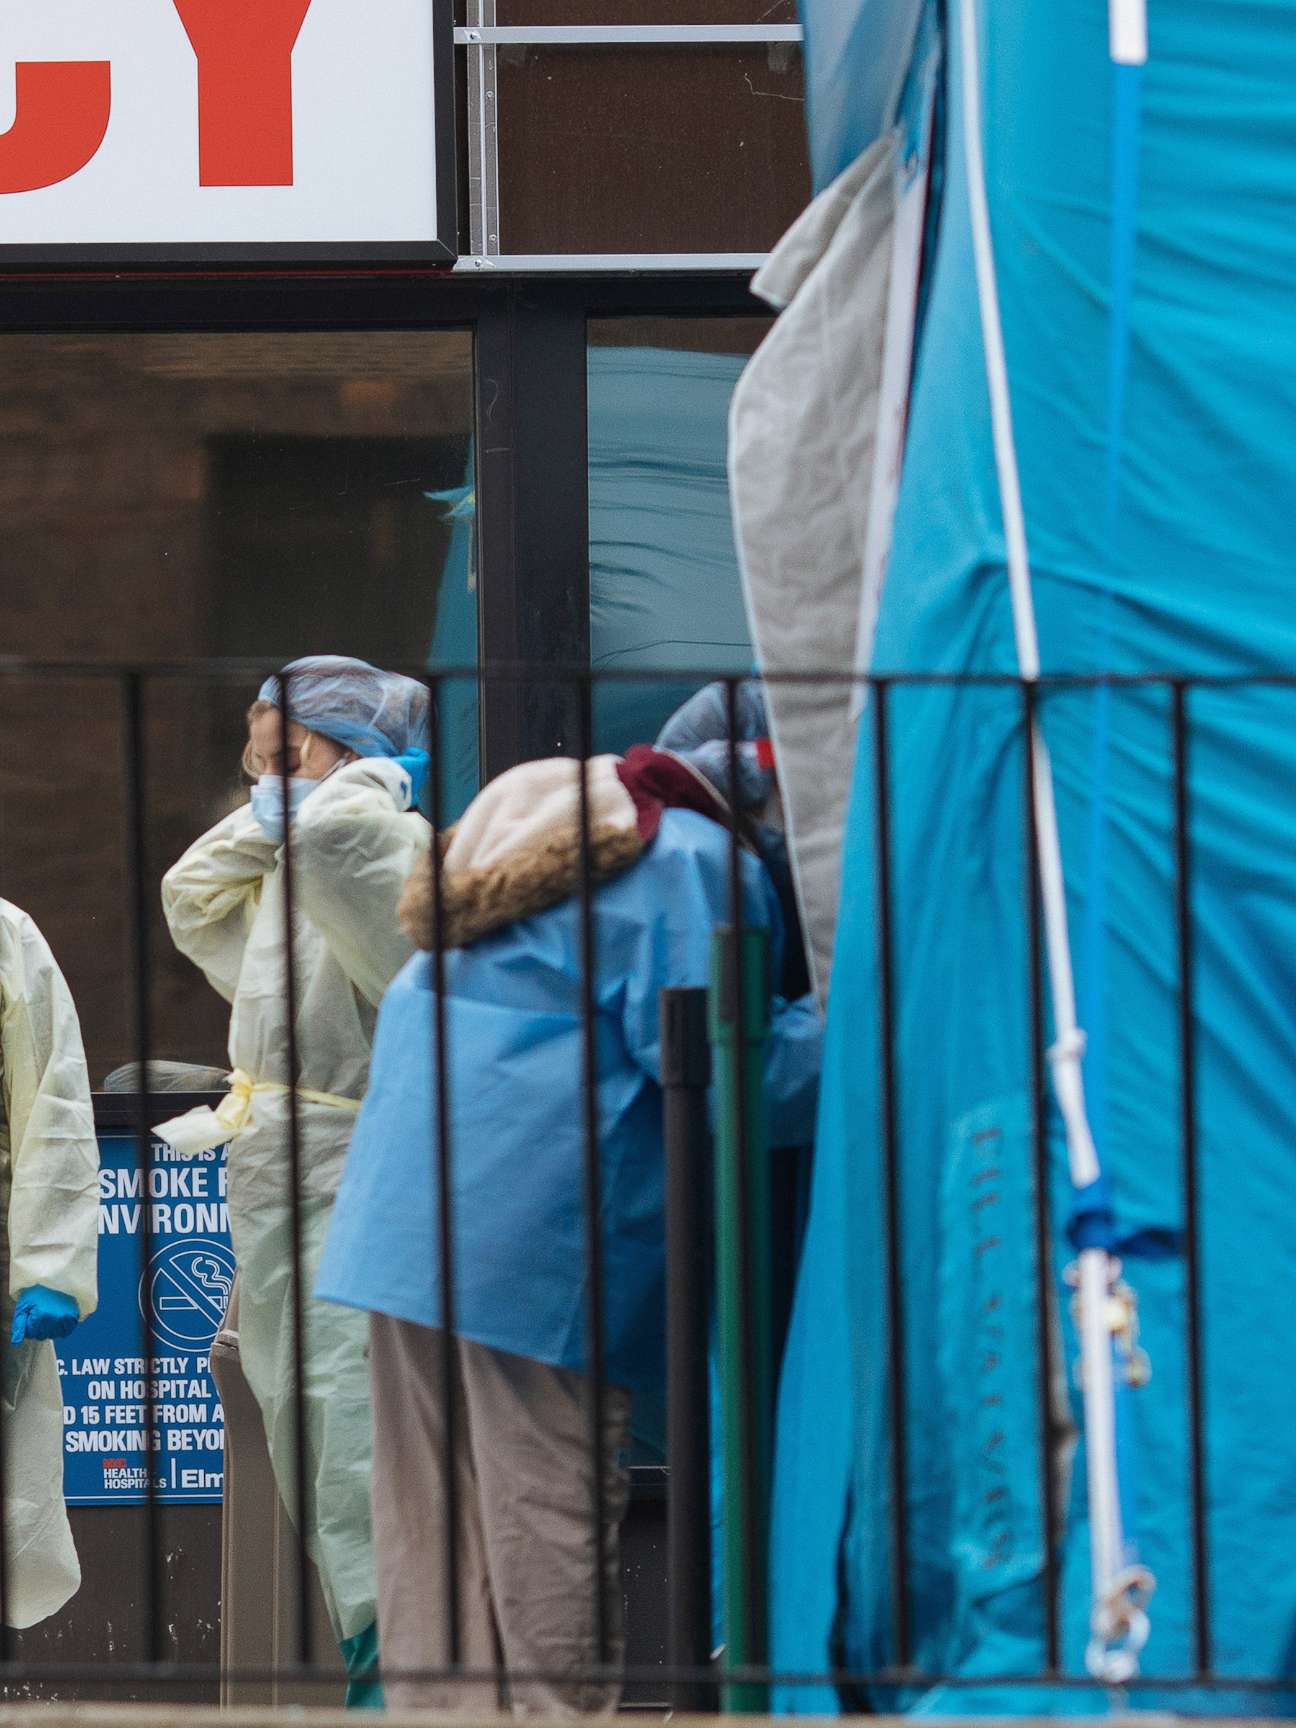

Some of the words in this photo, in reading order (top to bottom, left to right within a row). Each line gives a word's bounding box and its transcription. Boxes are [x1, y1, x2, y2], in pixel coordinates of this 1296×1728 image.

[97, 1167, 209, 1199] SMOKE
[98, 1203, 233, 1235] NVRON
[72, 1359, 111, 1375] LAW
[196, 1358, 212, 1374] P
[88, 1381, 115, 1400] ON
[120, 1379, 212, 1399] HOSPITAL
[81, 1406, 100, 1425] 15
[105, 1405, 148, 1424] FEET
[153, 1404, 207, 1424] FROM
[65, 1430, 161, 1452] SMOKING
[167, 1429, 225, 1450] BEYO
